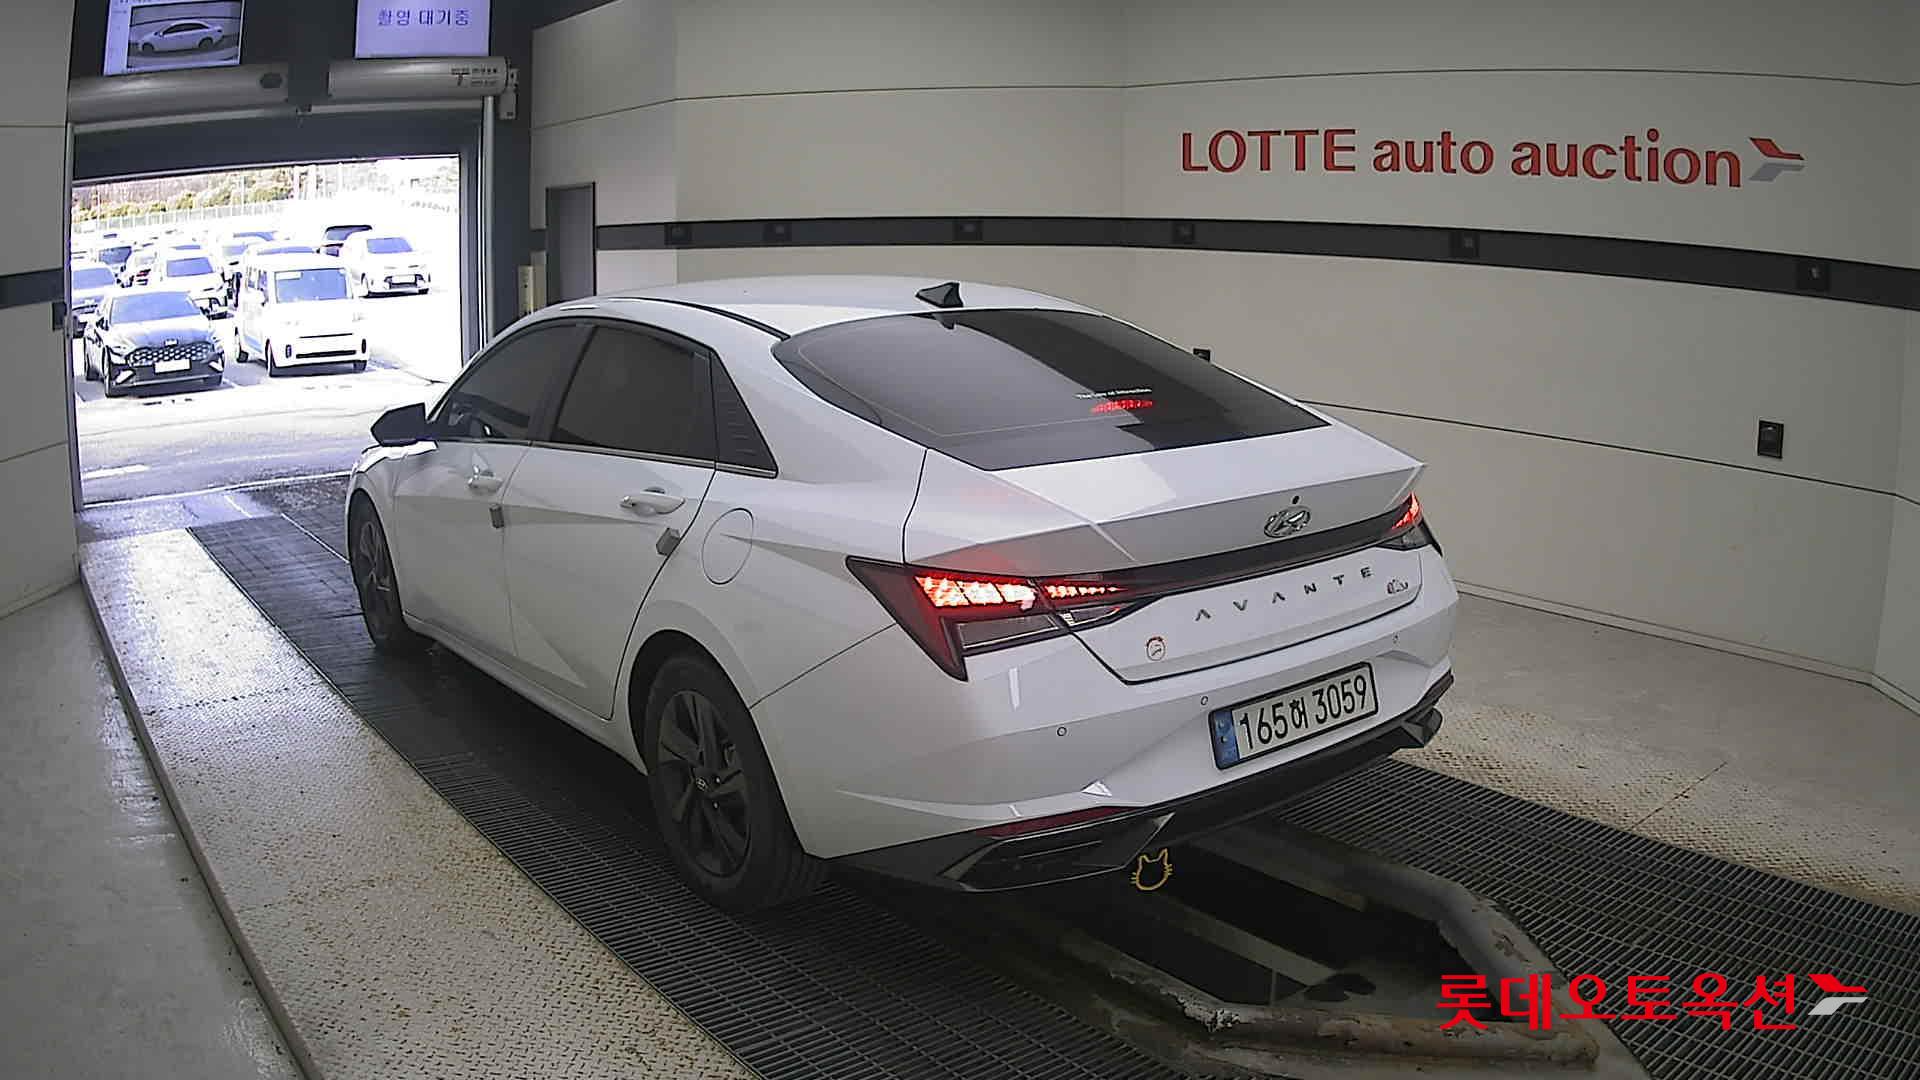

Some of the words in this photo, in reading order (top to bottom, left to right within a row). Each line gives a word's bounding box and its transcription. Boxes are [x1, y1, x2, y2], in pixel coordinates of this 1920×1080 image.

[418, 8, 469, 26] 대기중
[1180, 128, 1357, 173] LOTTE
[1373, 130, 1494, 175] auto
[1511, 128, 1741, 188] auction
[1194, 566, 1373, 622] AVANTE
[1239, 697, 1308, 750] 165허
[1311, 674, 1367, 725] 3059
